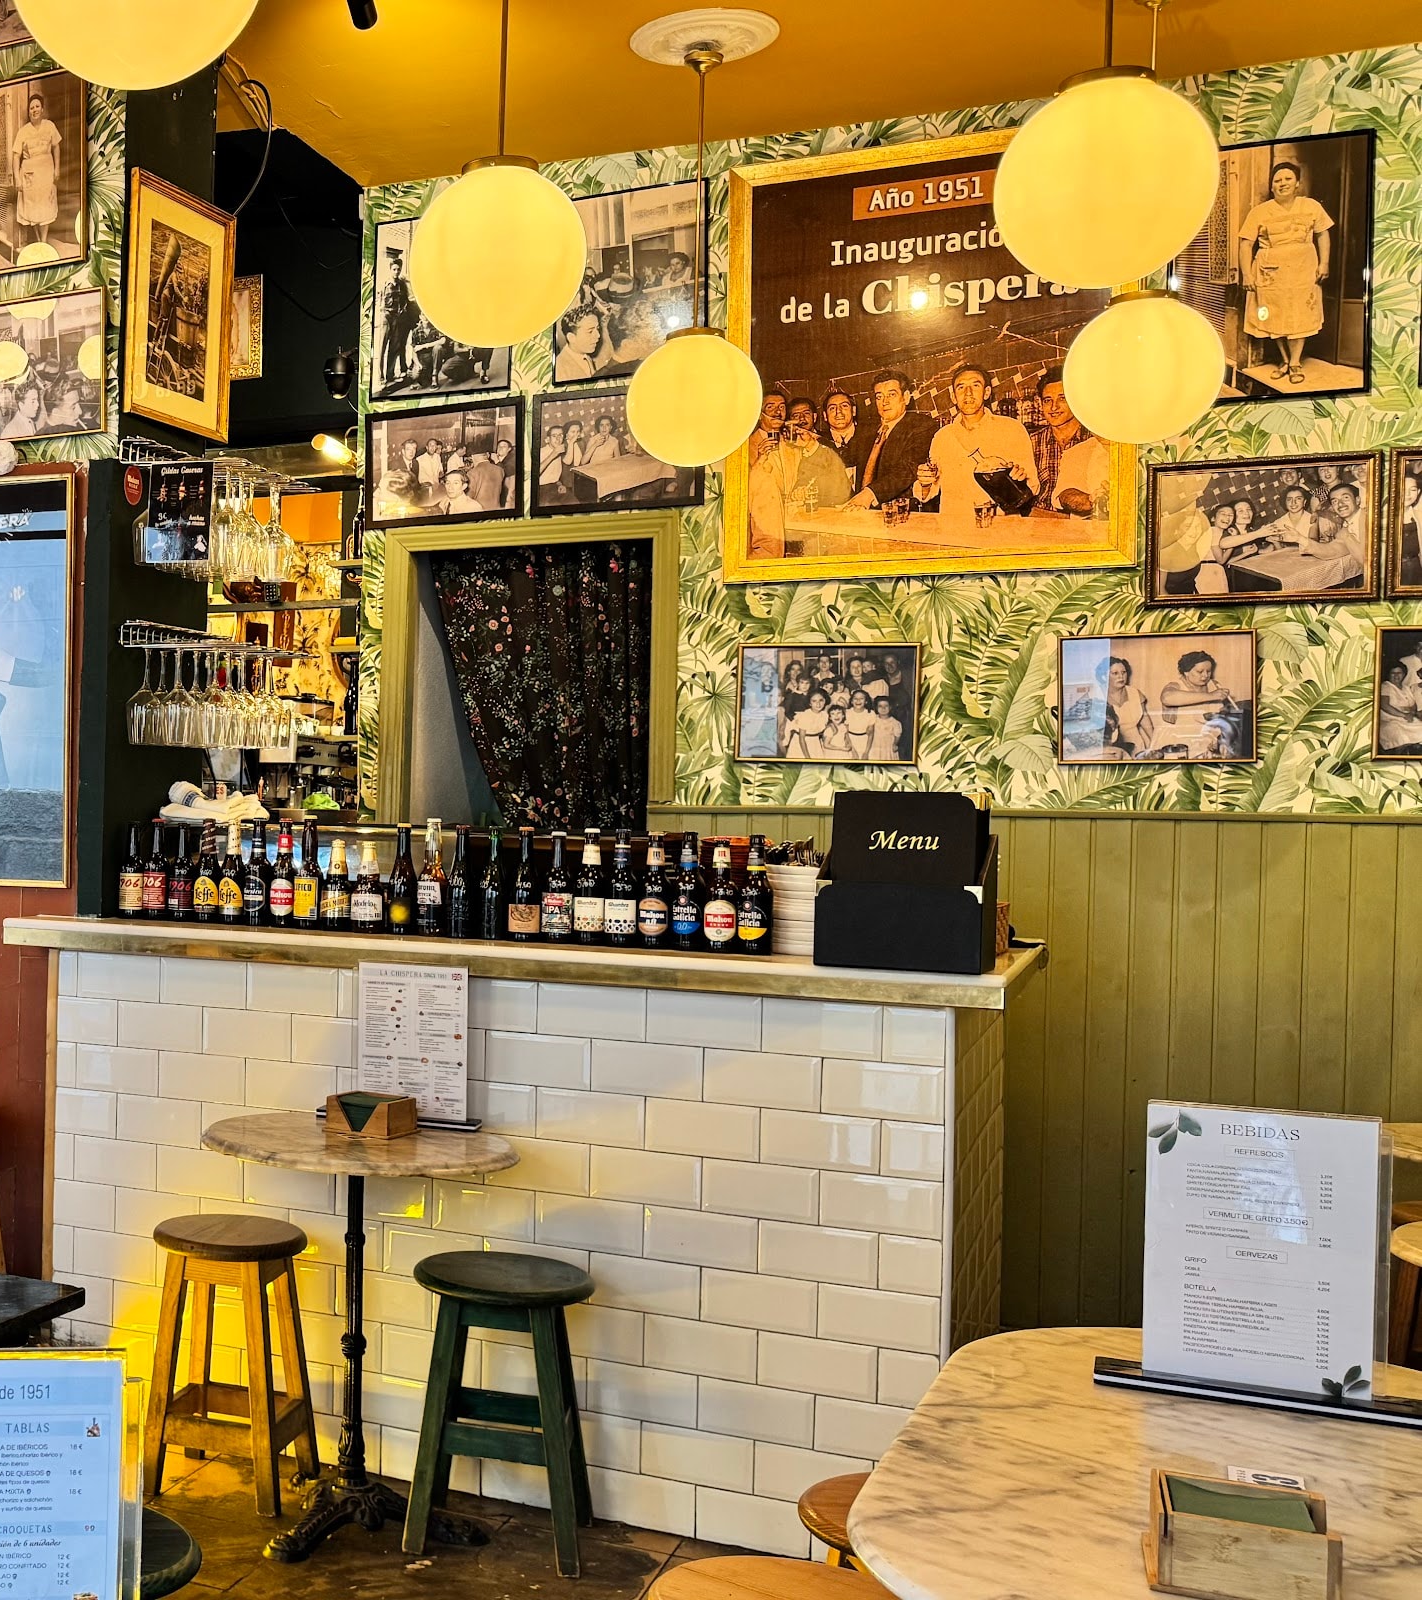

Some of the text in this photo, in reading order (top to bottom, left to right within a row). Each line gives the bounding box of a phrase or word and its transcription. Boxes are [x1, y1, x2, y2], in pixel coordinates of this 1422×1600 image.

[868, 175, 984, 212] Año 1951
[830, 220, 1004, 267] Inauguració
[780, 296, 813, 324] de
[823, 293, 850, 320] la
[868, 829, 940, 850] Menu
[195, 886, 215, 902] Leffe
[220, 887, 237, 904] Leffe
[270, 890, 292, 898] Mahou
[546, 906, 561, 914] IPA
[706, 914, 733, 923] Mahou
[391, 970, 422, 978] CHISPERA
[1221, 1123, 1300, 1141] BEBIDAS
[1234, 1148, 1284, 1158] REFRESCOS
[1208, 1211, 1241, 1219] VERMUT
[1255, 1215, 1282, 1223] GRIFO
[1185, 1256, 1207, 1264] GRIFO
[1235, 1250, 1278, 1260] CERVEZAS
[1184, 1283, 1216, 1292] BOTELLA
[20, 1385, 51, 1399] 1951
[6, 1423, 50, 1434] TABLAS
